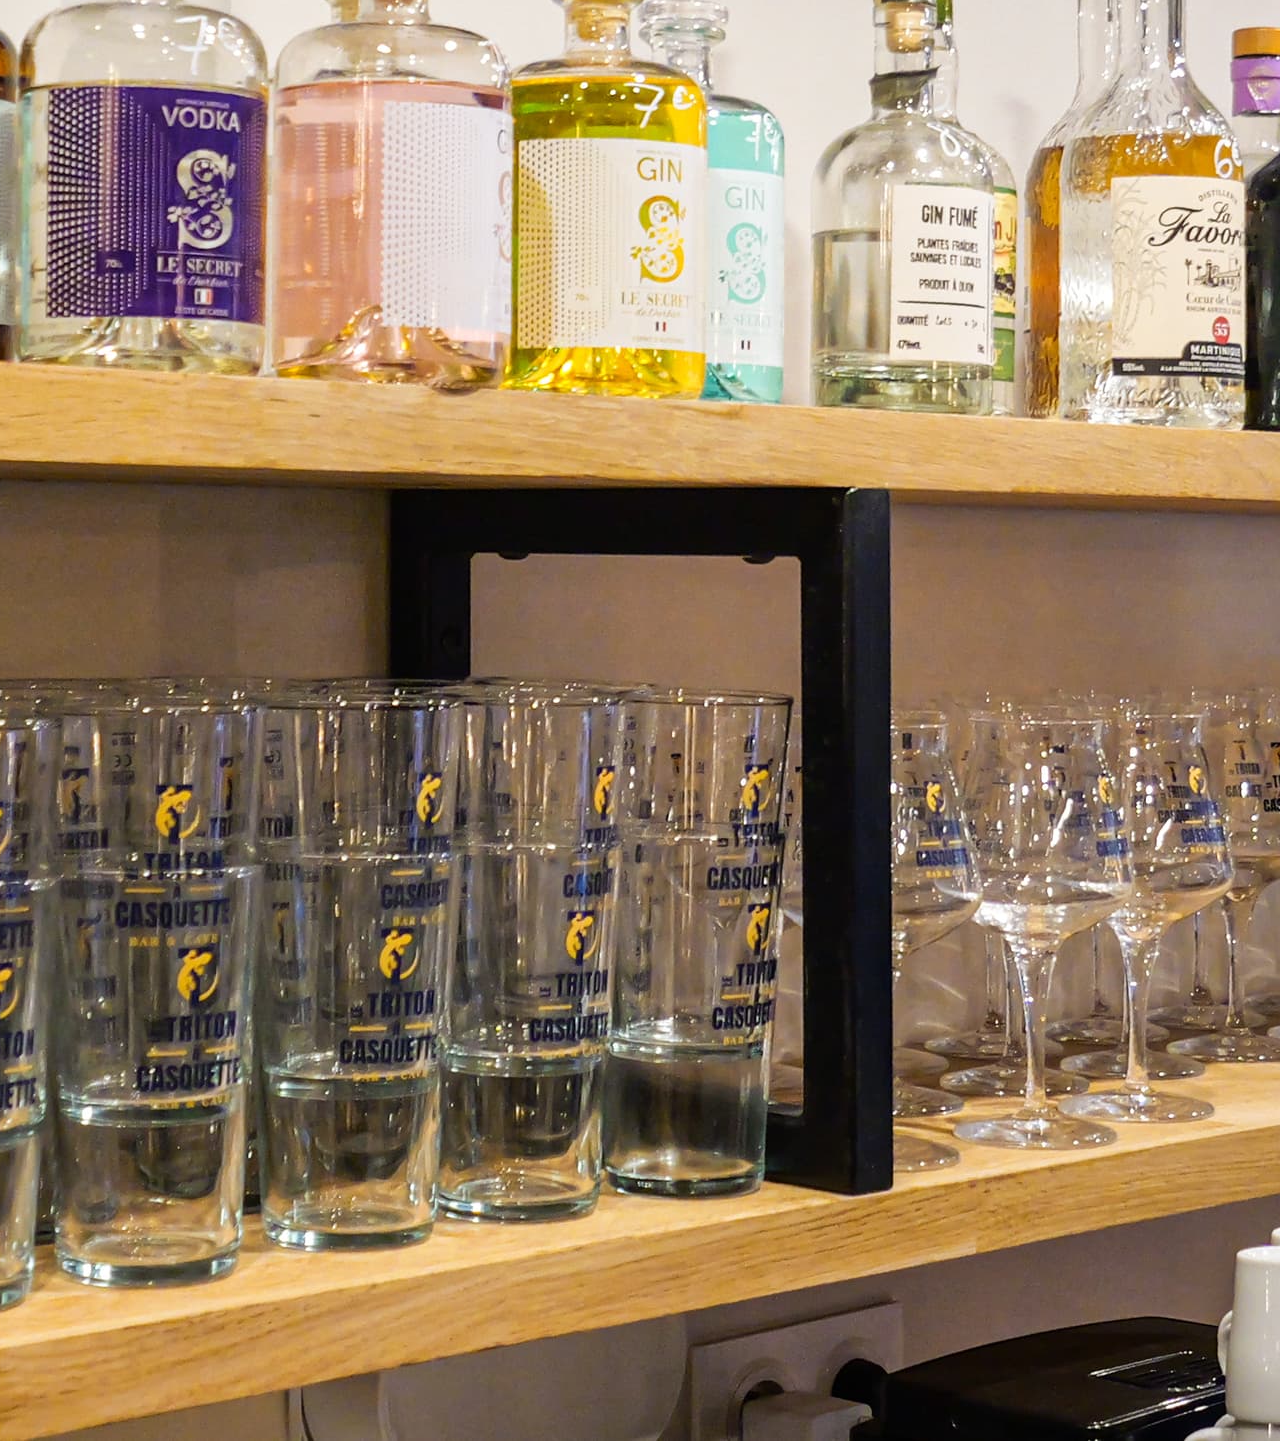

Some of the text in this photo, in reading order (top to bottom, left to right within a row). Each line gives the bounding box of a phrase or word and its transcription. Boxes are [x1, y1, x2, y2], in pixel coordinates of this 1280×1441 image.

[162, 105, 241, 133] VODKA
[636, 156, 683, 183] GIN
[724, 186, 766, 211] GIN
[922, 206, 978, 229] GIN FUMÉ
[1208, 201, 1233, 225] La
[917, 238, 950, 251] PLANTES
[157, 256, 243, 278] LE SECRET
[949, 255, 958, 266] ET
[919, 278, 950, 291] PRODUIT
[621, 291, 641, 306] LE
[114, 898, 230, 930] CASQUETTE
[555, 970, 608, 998] TRITON
[368, 990, 436, 1018] TRITON
[169, 1010, 237, 1043] TRITON
[339, 1035, 438, 1065] CASQUETTE
[135, 1057, 239, 1093] CASQUETTE
